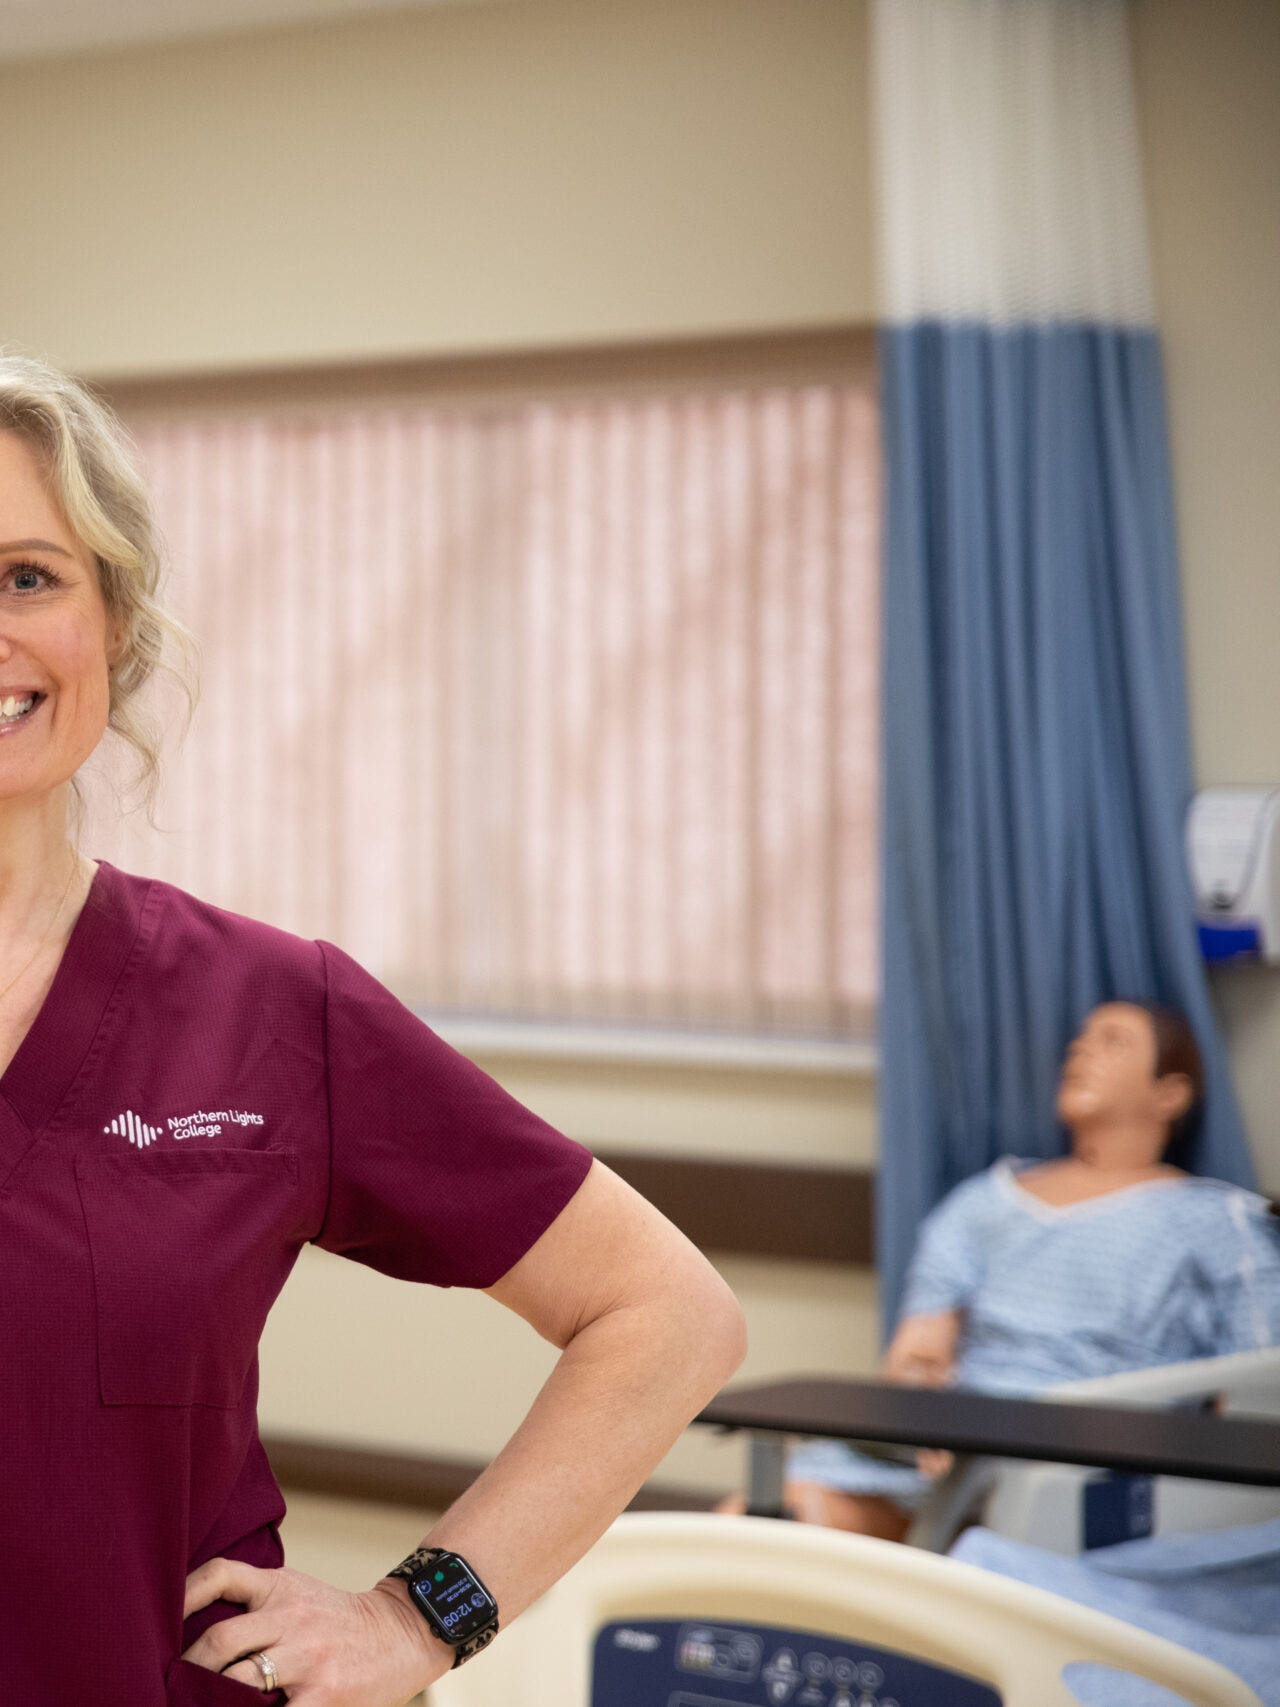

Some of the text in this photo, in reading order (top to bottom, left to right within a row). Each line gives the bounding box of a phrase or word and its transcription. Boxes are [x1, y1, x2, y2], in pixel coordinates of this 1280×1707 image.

[167, 1109, 264, 1130] Northern Lights
[173, 1124, 222, 1140] College
[443, 1602, 472, 1627] 12:09
